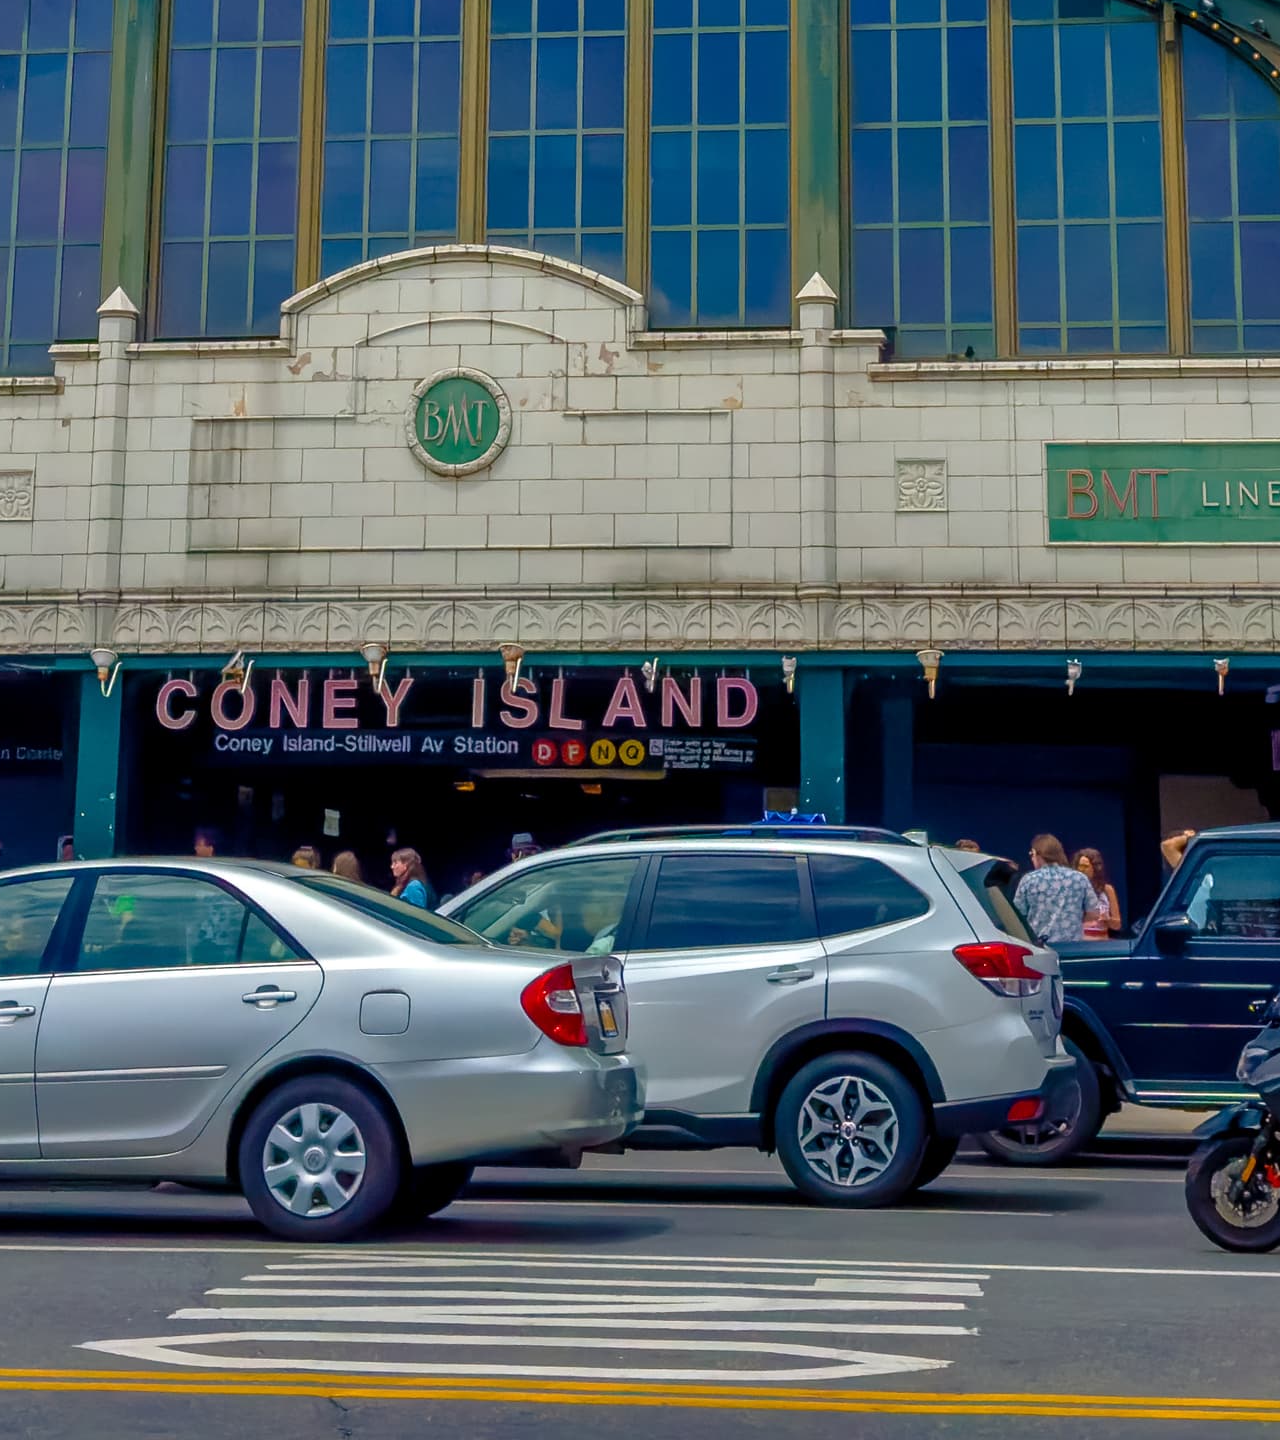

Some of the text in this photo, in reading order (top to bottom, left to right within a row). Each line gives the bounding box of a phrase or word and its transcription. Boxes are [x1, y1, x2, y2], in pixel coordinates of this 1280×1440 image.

[423, 391, 489, 447] BMT
[1067, 468, 1169, 520] BMT
[155, 676, 759, 731] CONEY ISLAND
[214, 733, 639, 762] Coney Island-Stillwell Av Station D F N Q
